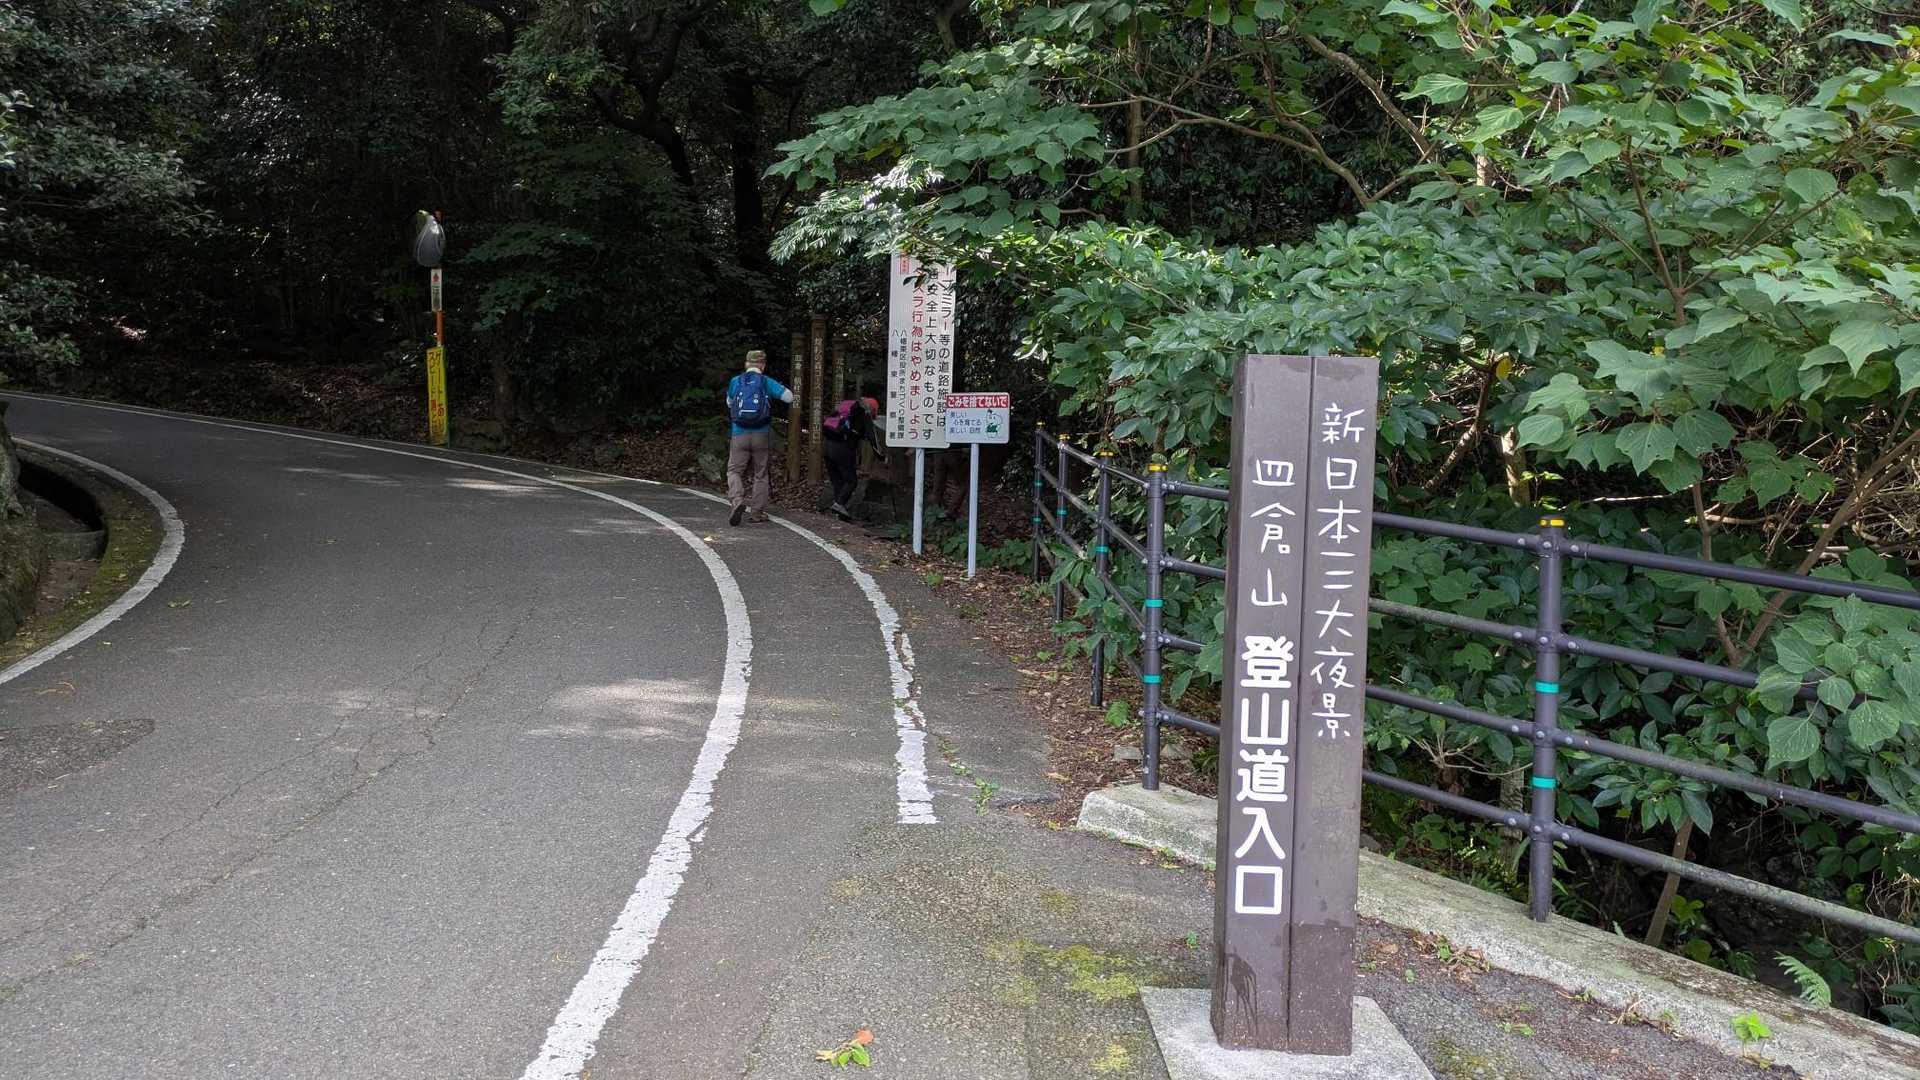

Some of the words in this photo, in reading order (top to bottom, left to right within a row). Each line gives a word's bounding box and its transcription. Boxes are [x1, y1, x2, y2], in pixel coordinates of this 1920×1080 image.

[922, 267, 940, 441] 通安全上大切なものです
[936, 267, 955, 428] ーブミラー等の道路施設は
[947, 395, 1007, 408] ごみを捨てないで
[1310, 403, 1365, 738] 新日本三大夜景
[1234, 634, 1294, 916] 登山道入口
